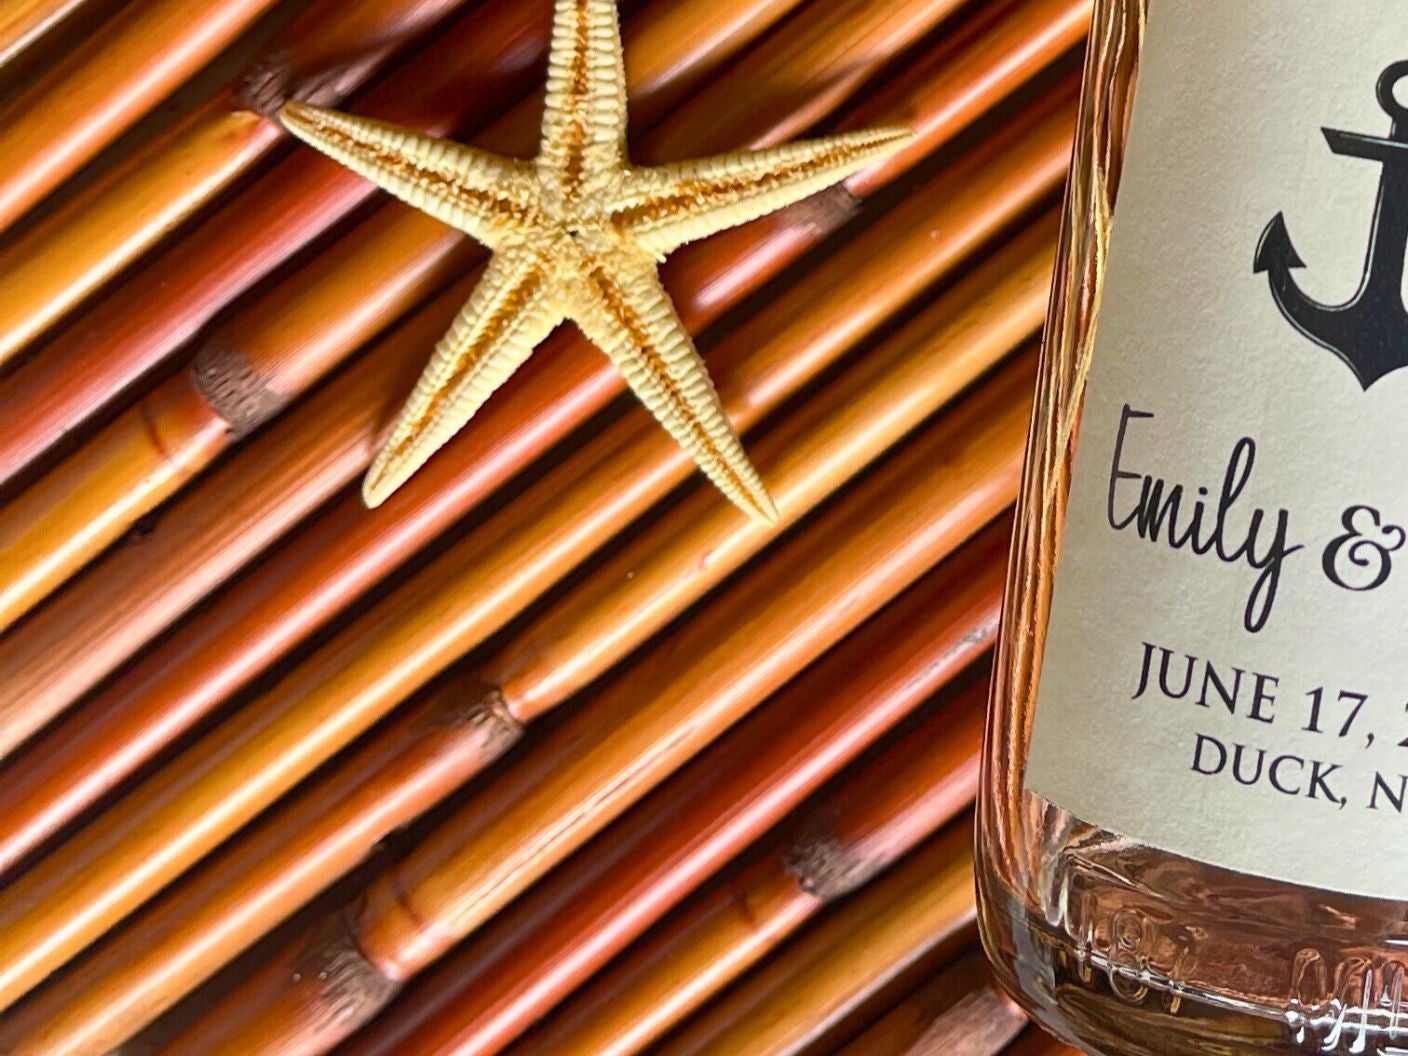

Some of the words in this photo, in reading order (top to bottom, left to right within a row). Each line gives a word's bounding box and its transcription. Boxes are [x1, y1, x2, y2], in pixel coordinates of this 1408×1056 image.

[1107, 402, 1306, 634] Emily
[1321, 504, 1407, 592] &
[1130, 640, 1280, 724] JUNE
[1301, 686, 1376, 749] 17,
[1189, 732, 1348, 810] DUCK,
